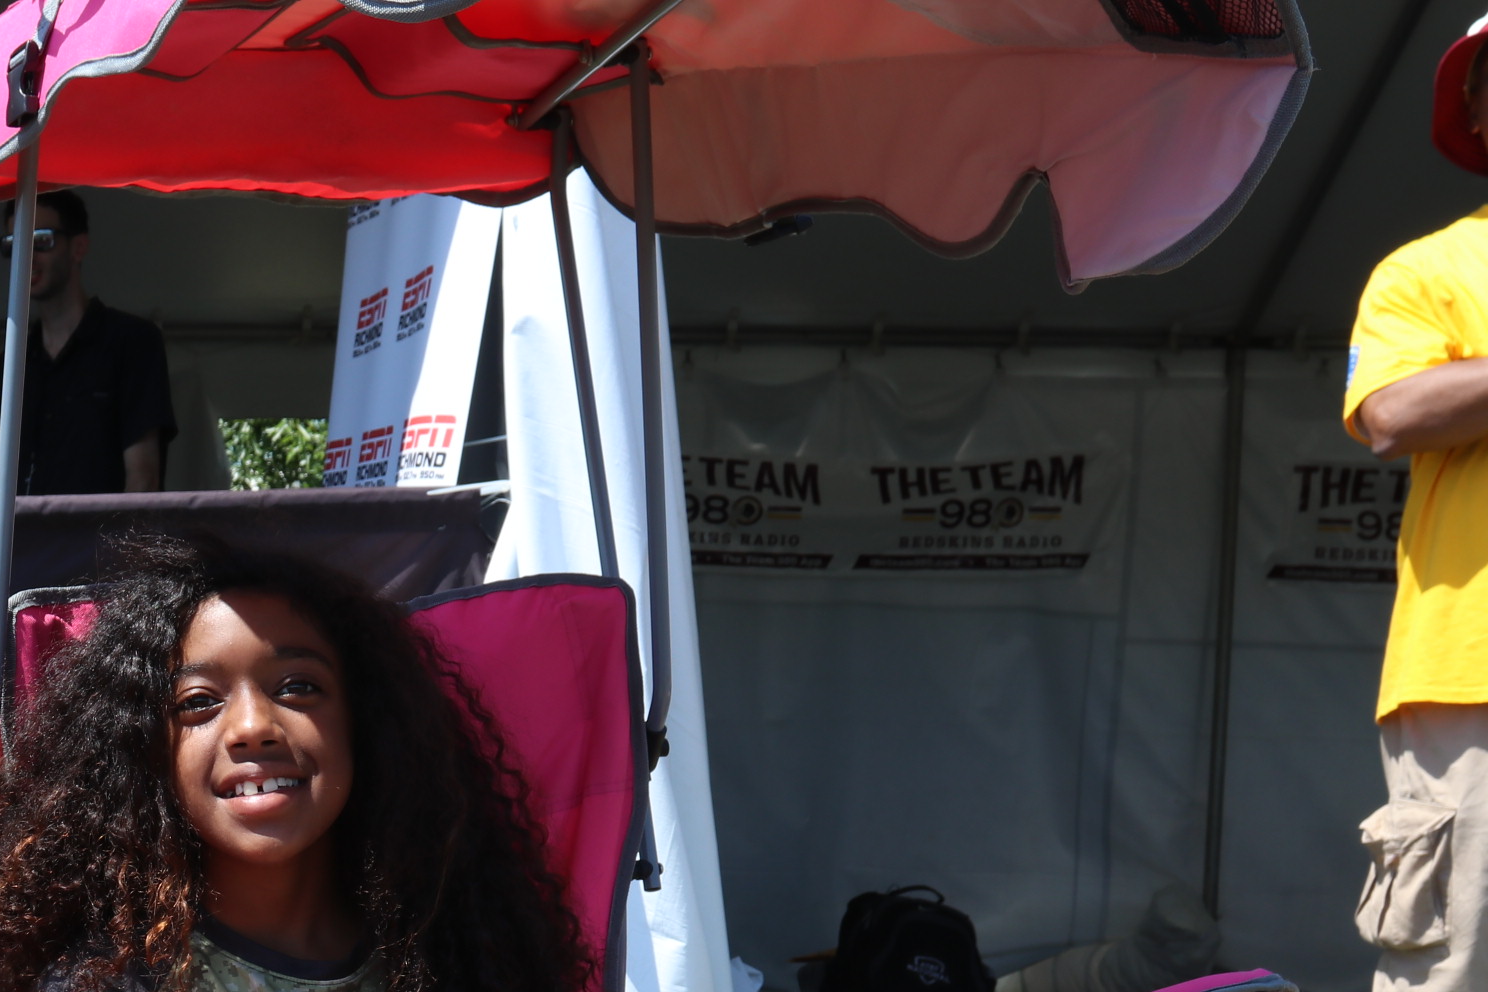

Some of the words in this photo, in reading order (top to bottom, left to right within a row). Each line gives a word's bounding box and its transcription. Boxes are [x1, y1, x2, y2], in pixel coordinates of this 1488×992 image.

[699, 456, 820, 506] TEAM
[870, 466, 957, 505] THE
[960, 455, 1085, 505] TEAM
[1294, 465, 1380, 512] THE
[740, 534, 800, 547] RADIO
[898, 536, 995, 549] REDSKINS
[1002, 535, 1063, 548] RADIO
[1357, 510, 1404, 542] 98
[1315, 547, 1397, 561] REDSKI
